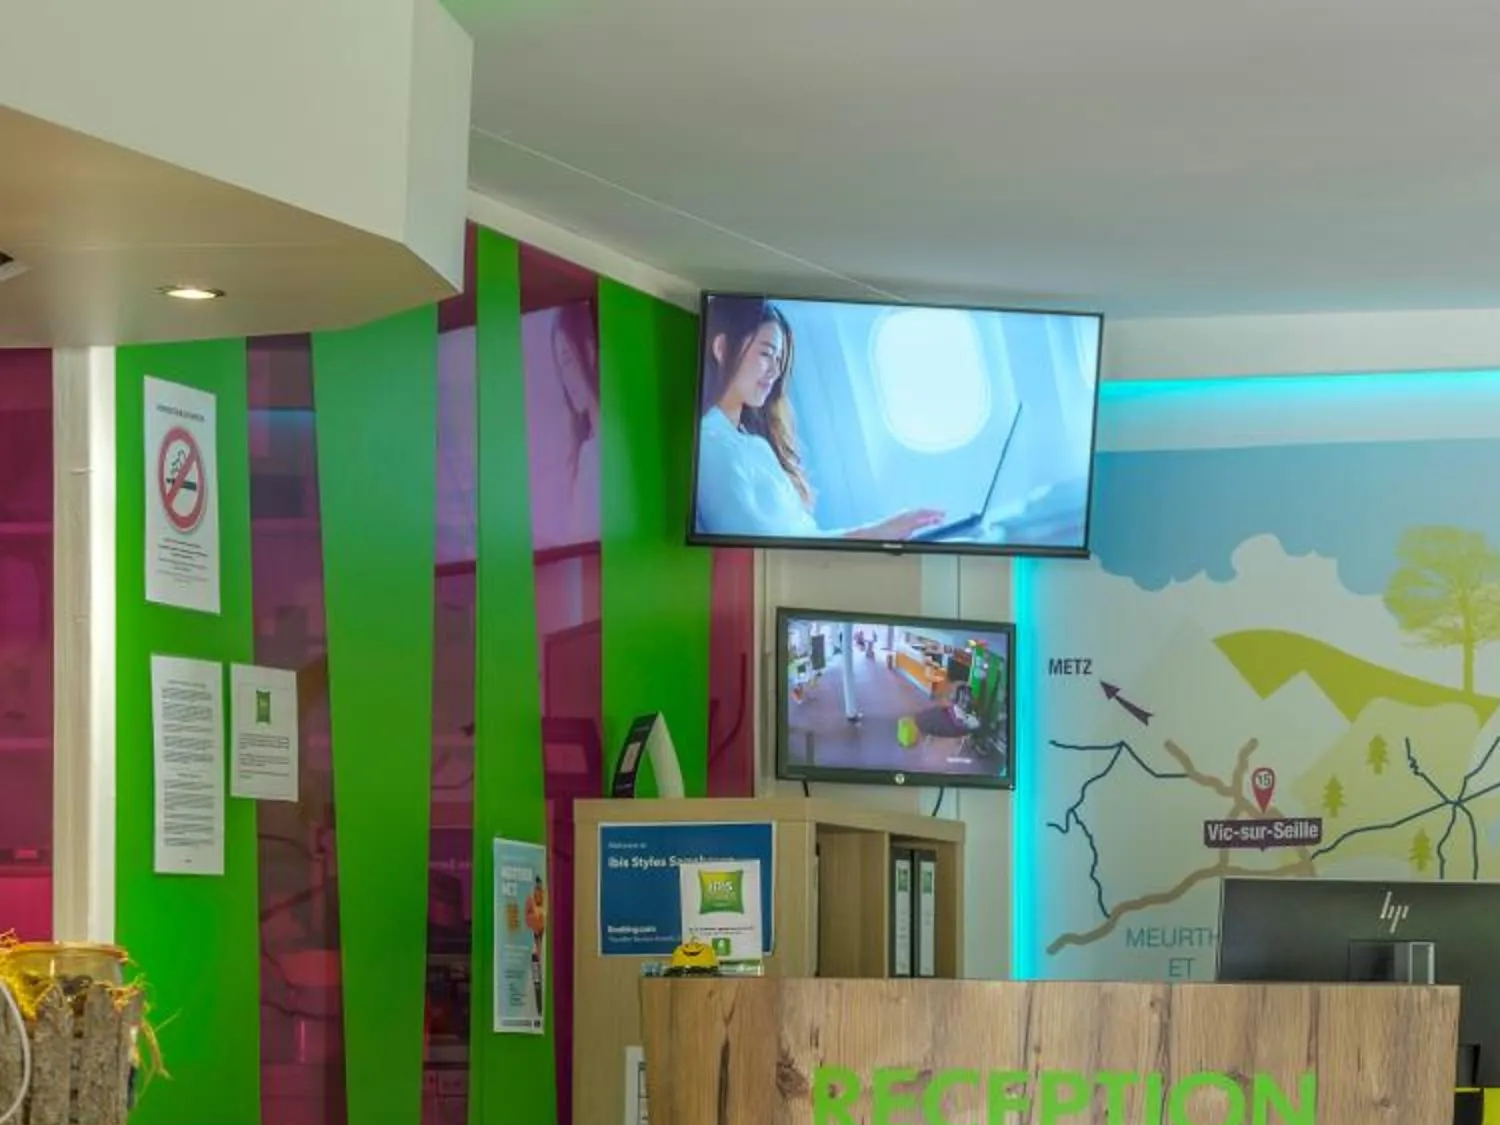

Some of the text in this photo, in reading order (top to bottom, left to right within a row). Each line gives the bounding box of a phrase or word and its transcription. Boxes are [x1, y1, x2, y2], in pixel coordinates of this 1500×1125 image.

[1048, 659, 1092, 675] METZ
[1257, 773, 1271, 787] 15
[1207, 821, 1319, 841] Vic-sur-Seille
[1379, 891, 1410, 933] hp
[1125, 928, 1220, 948] MEURTH
[1169, 958, 1195, 977] ET
